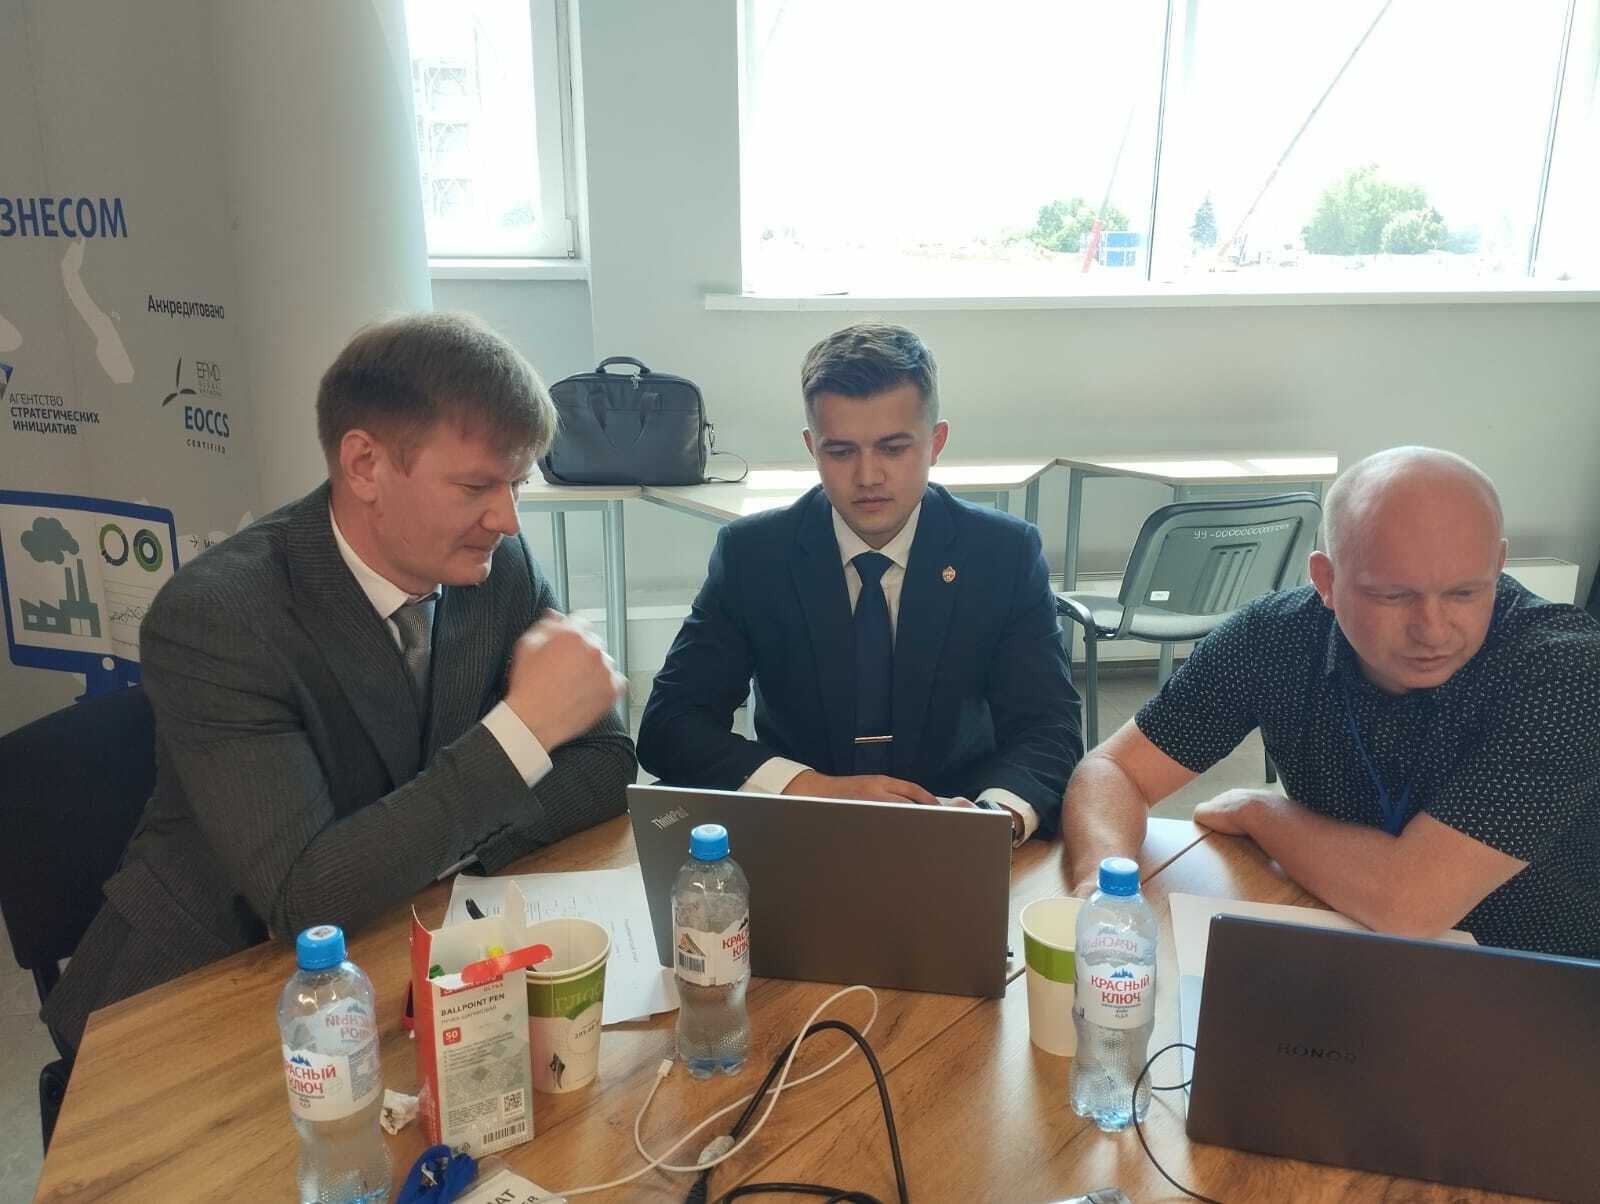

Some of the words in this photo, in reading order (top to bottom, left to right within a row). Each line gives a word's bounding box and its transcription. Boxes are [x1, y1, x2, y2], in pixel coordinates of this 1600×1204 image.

[0, 198, 128, 238] ЗНЕСОМ
[148, 294, 225, 319] Аккредитовано
[9, 393, 64, 406] АГЕНТСТВО
[10, 406, 100, 424] СТРАТЕГИЧЕСКИХ
[185, 405, 230, 438] EOCCS
[13, 420, 77, 434] ИНИЦИАТИВ
[1091, 974, 1150, 991] КРАСНЫЙ
[441, 998, 487, 1016] BALLPOINT
[490, 993, 505, 1003] PEN
[1102, 992, 1141, 1004] КЛЮЧ
[445, 1031, 458, 1040] 50
